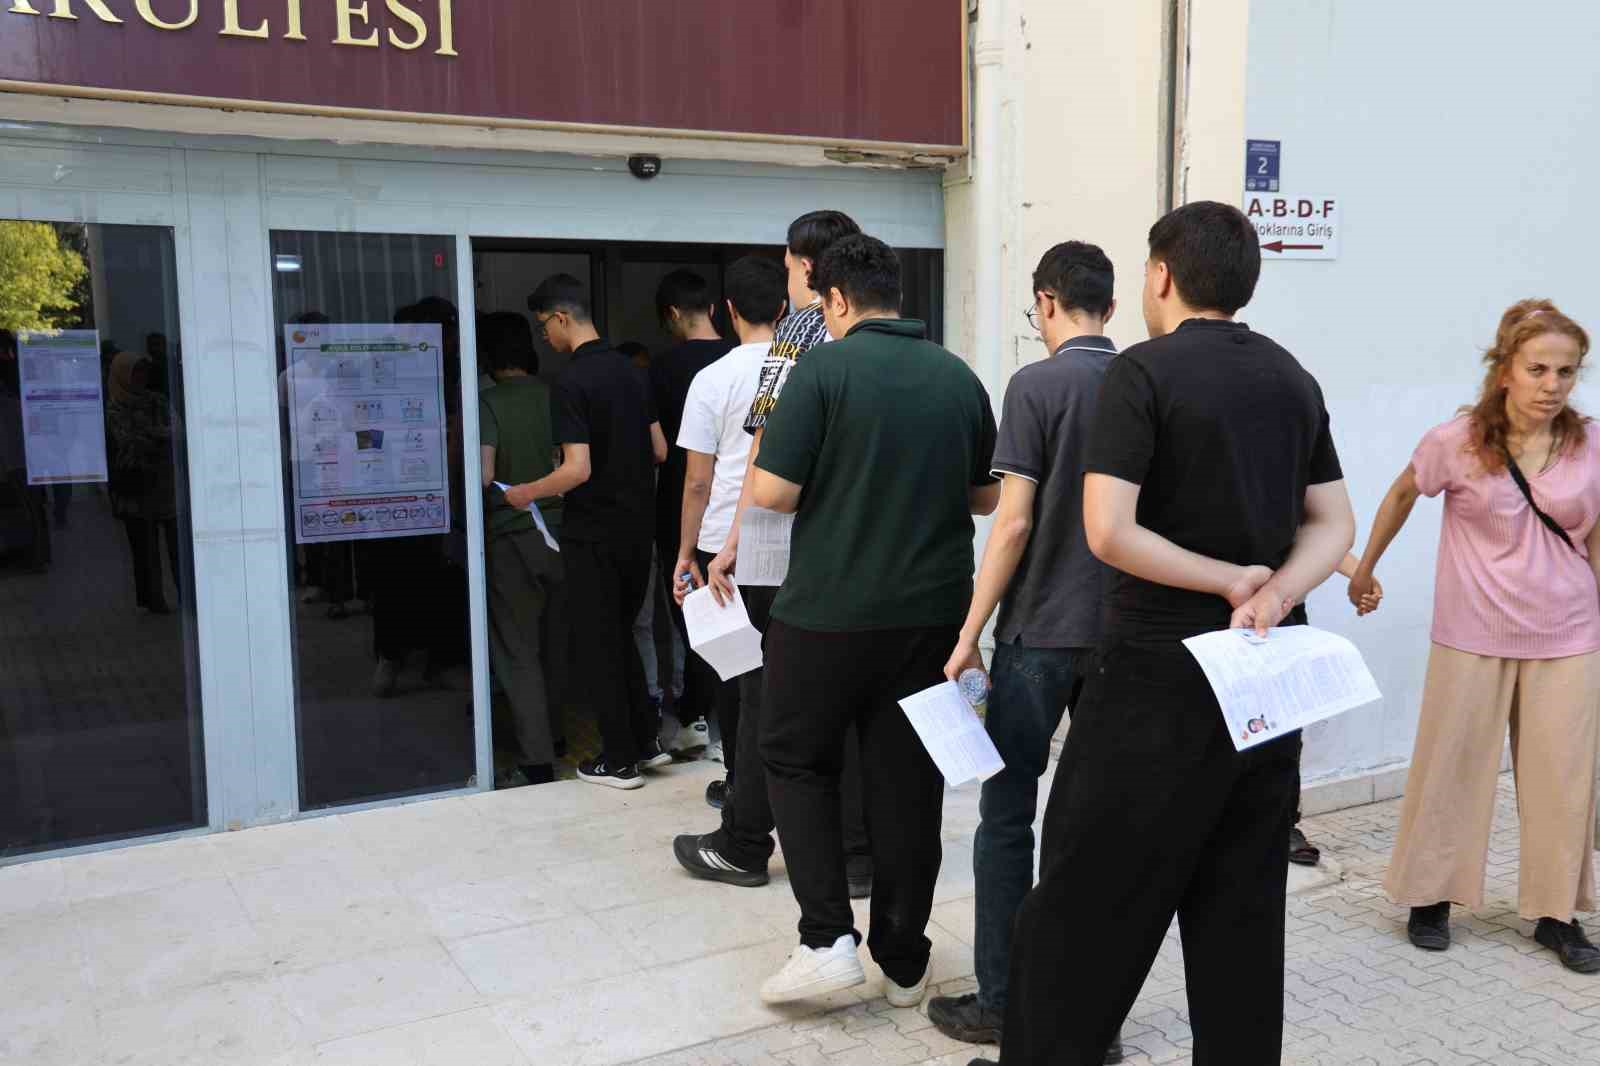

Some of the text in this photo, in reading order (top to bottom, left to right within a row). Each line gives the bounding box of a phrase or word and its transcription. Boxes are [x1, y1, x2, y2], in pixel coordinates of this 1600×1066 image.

[1257, 156, 1268, 174] 2
[1247, 198, 1335, 218] A-B-D-F
[1255, 222, 1334, 240] loklarına Giriş
